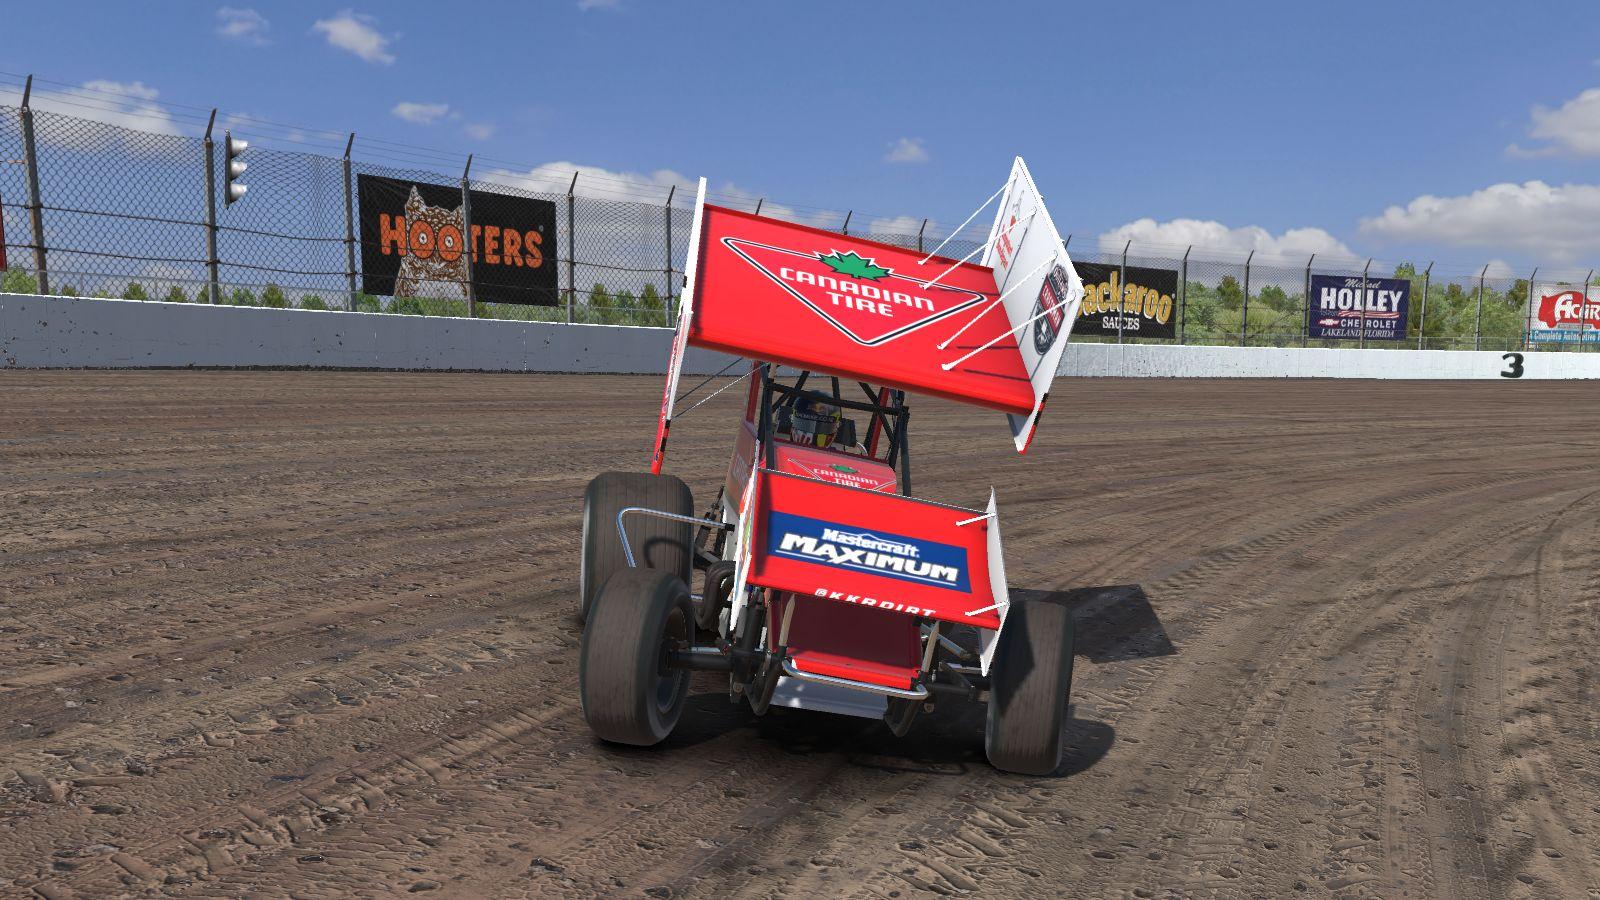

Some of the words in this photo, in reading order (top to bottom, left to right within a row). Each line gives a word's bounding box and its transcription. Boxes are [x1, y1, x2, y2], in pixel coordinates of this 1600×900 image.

[379, 213, 543, 269] HOOTERS
[780, 267, 935, 312] CANADIAN
[1077, 271, 1173, 325] ackaroo
[1320, 287, 1403, 312] HOLLEY
[826, 291, 894, 317] TIRE
[1102, 316, 1140, 330] SAUCES
[1340, 319, 1397, 329] CHEROLET
[1500, 353, 1525, 379] 3
[813, 468, 879, 486] CANADIAN
[779, 533, 959, 583] MAXIMUM
[814, 588, 937, 617] @KKRDIRT
